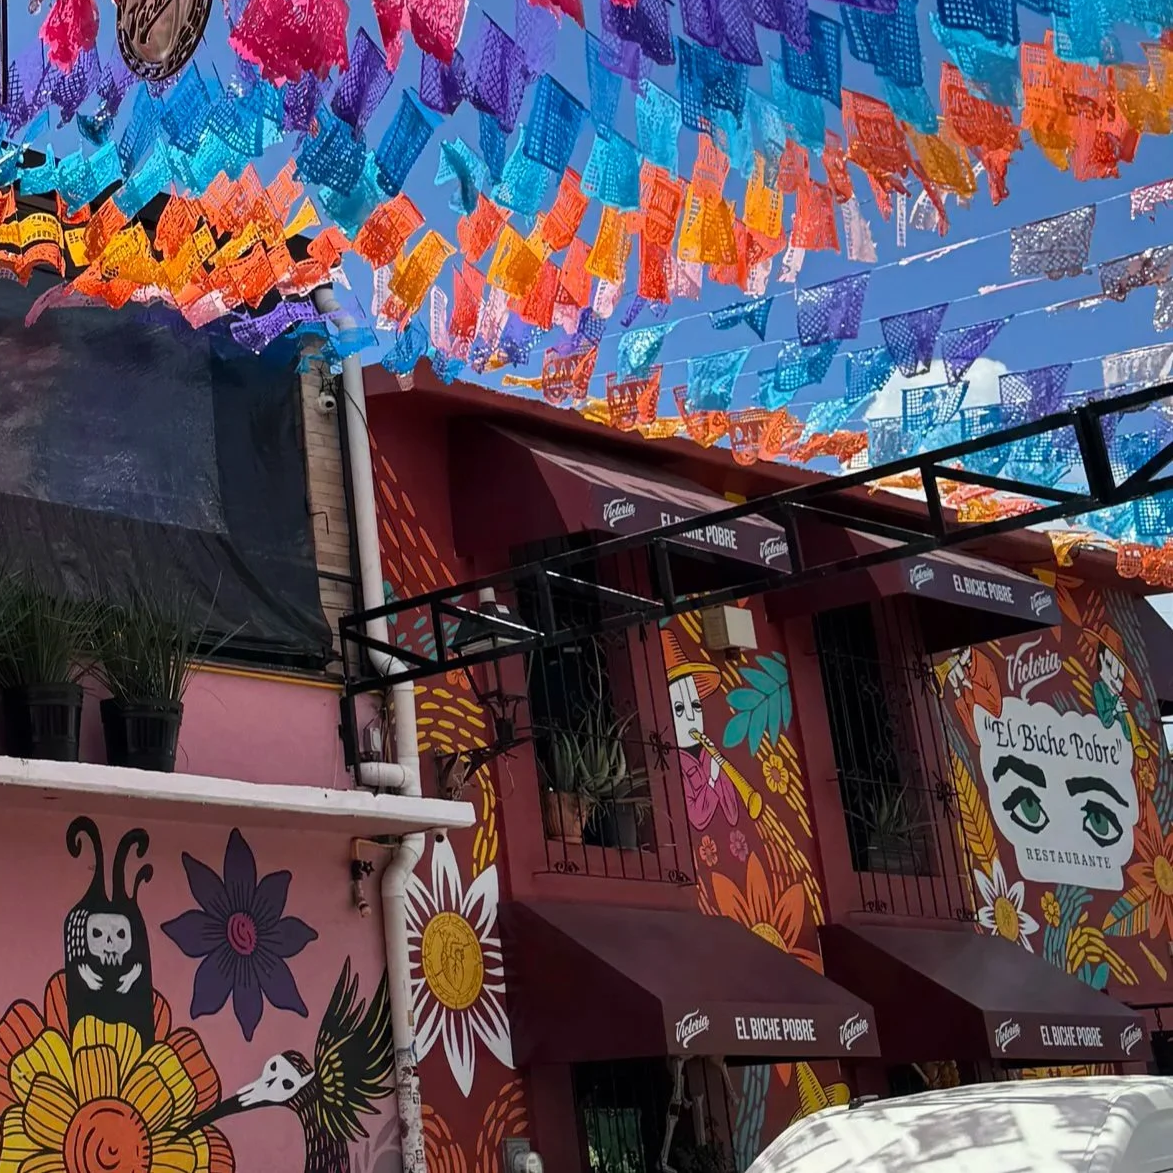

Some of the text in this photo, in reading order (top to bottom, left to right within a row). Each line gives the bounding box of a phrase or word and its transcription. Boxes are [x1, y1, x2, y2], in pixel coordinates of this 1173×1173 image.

[603, 497, 636, 527] Victoria
[706, 525, 738, 550] POBRE
[759, 535, 788, 565] Victoria
[909, 563, 934, 590] Victoria
[952, 574, 1015, 604] EL BICHE POBRE
[1030, 590, 1053, 616] Victoria
[1005, 635, 1063, 701] Victoria
[1017, 724, 1068, 757] Biche
[1026, 847, 1112, 869] RESTAURANTE
[675, 1008, 710, 1048] Victoria
[735, 1016, 817, 1041] EL BICHE POBRE
[839, 1012, 869, 1051] Victoria
[994, 1018, 1021, 1052] Victoria
[1040, 1025, 1104, 1047] EL BICHE POBRE
[1120, 1022, 1143, 1056] Victoria
